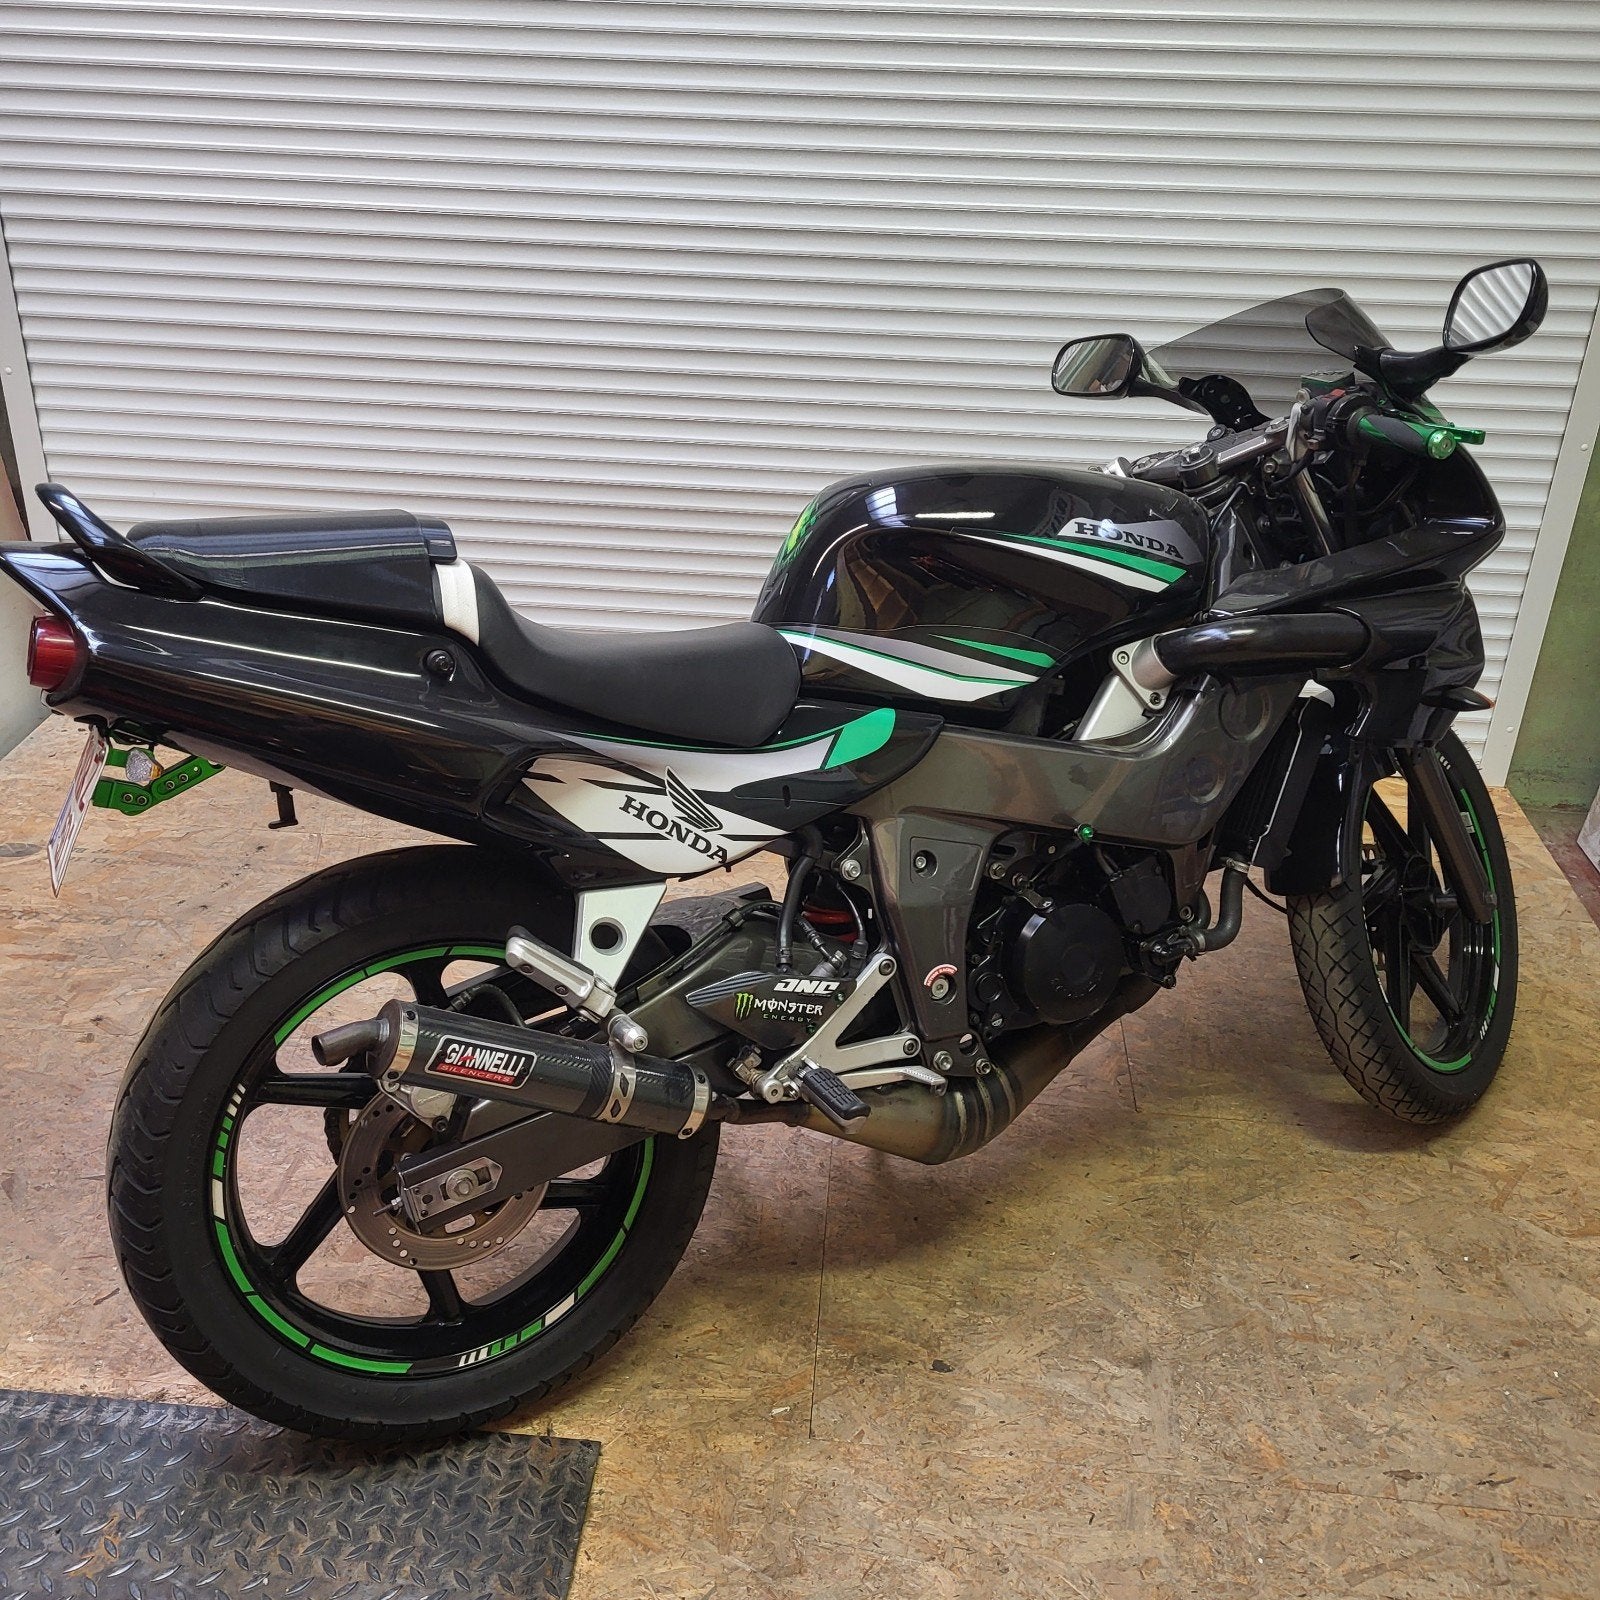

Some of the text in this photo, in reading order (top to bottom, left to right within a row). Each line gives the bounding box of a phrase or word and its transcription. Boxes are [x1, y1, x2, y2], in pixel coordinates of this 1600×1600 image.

[619, 795, 729, 865] HONDA
[754, 998, 823, 1016] MONSTER
[763, 1013, 812, 1023] ENERGY
[444, 1043, 526, 1077] GIANNELLI
[440, 1064, 511, 1083] SILENCERS
